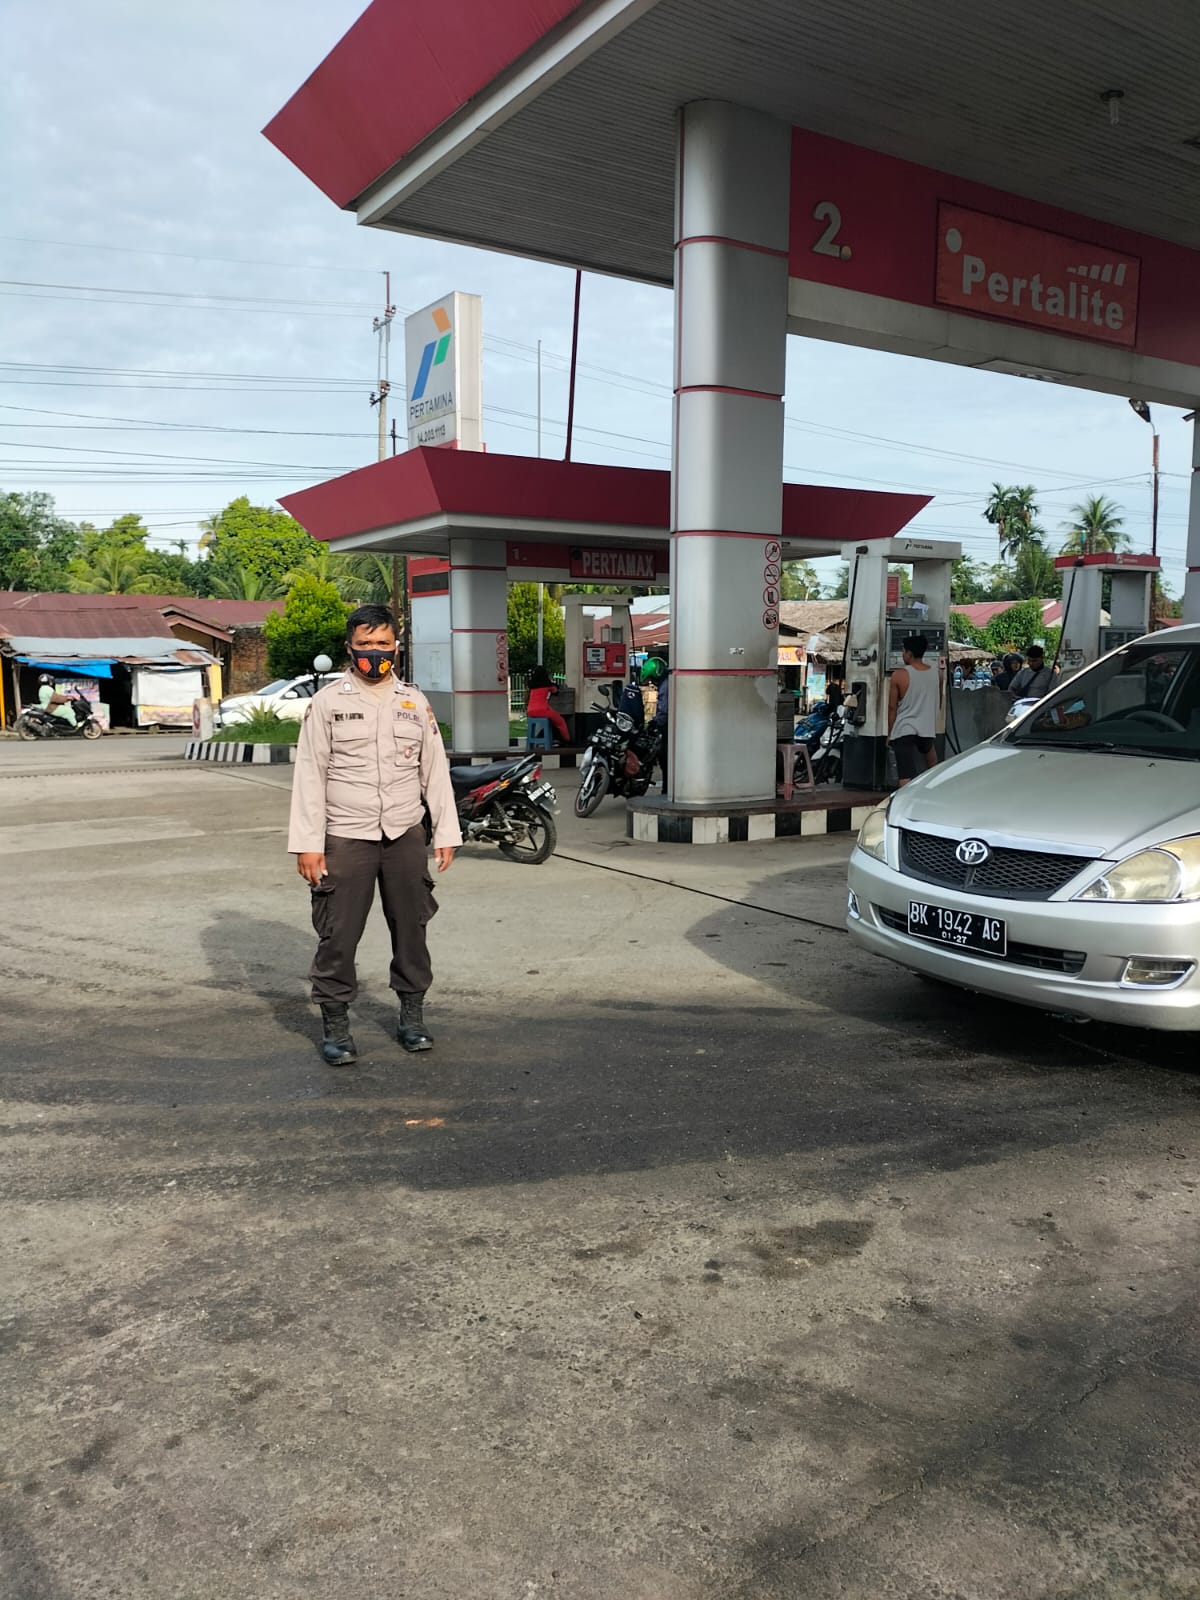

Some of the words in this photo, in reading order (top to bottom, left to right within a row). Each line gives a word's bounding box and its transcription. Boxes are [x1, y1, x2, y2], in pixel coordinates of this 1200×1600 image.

[812, 201, 852, 260] 2.
[962, 253, 1125, 331] Pertalite
[409, 391, 454, 419] PERTAMINA
[581, 551, 655, 577] PERTAMAX
[910, 902, 929, 926] BK
[937, 908, 973, 936] 1942
[982, 918, 1001, 941] AG
